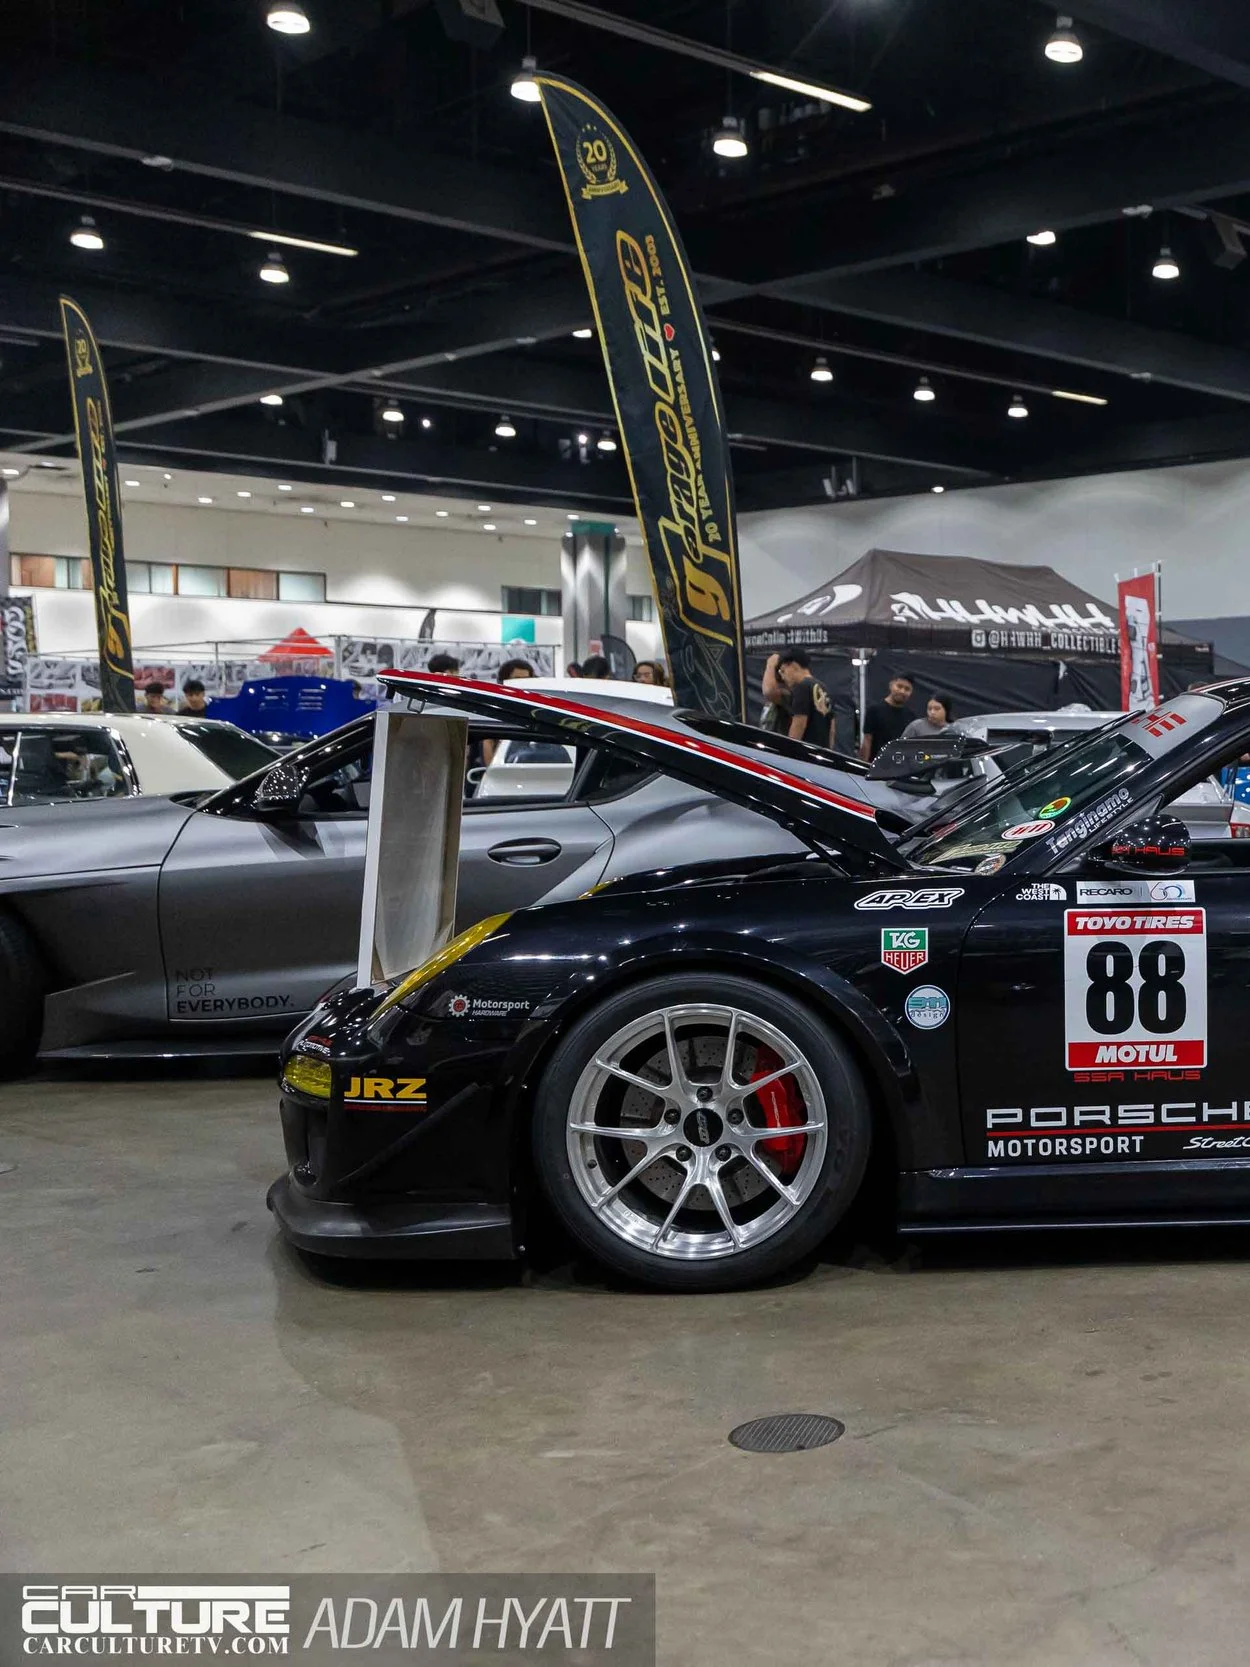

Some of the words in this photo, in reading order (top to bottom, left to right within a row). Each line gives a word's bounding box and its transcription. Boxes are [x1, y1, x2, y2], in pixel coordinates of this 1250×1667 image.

[582, 139, 607, 163] 20
[1135, 846, 1184, 856] HAUS
[1080, 887, 1133, 896] RECARO
[1076, 916, 1131, 930] TOYO
[1133, 916, 1195, 929] TIRES
[889, 931, 920, 949] TAG
[885, 952, 924, 971] HEUER
[176, 968, 215, 981] NOT
[176, 983, 216, 997] FOR
[1086, 940, 1187, 1035] 88
[177, 995, 294, 1013] EVERYBODY.
[473, 999, 530, 1011] Motorsport
[1095, 1045, 1178, 1063] MOTUL
[1134, 1070, 1200, 1081] HAUS
[344, 1077, 427, 1098] JRZ
[987, 1136, 1144, 1158] MOTORSPORT
